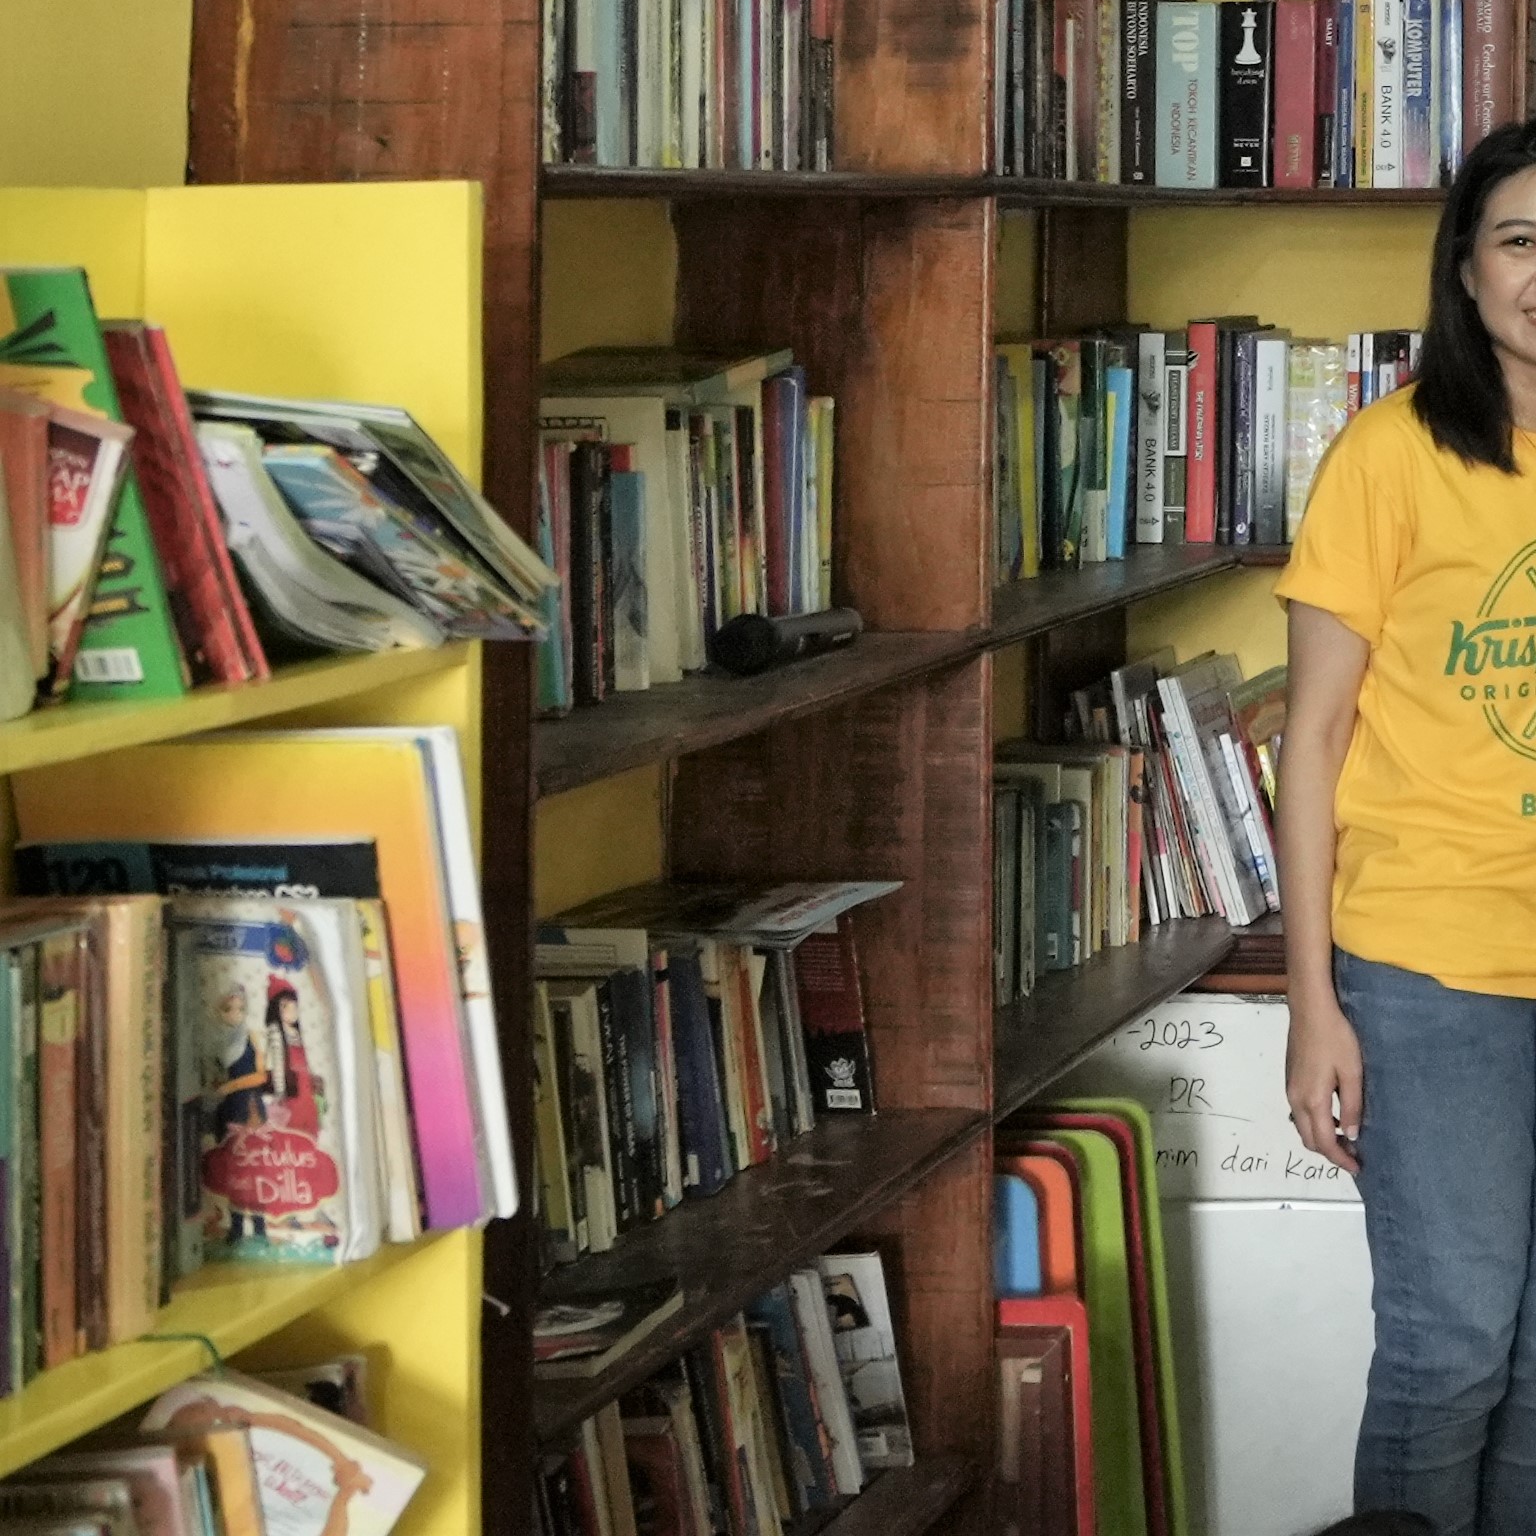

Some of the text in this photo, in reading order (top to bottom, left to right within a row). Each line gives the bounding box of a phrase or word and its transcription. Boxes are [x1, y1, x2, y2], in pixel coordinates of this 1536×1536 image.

[1126, 1, 1137, 100] BEYOND SOEHARTO
[1138, 1, 1149, 56] INDONESIA
[1171, 11, 1200, 73] TOP
[1406, 18, 1423, 98] KOMPUTER
[1171, 102, 1182, 156] INDONESIA
[1186, 78, 1198, 182] TOKOH KECANTIKAN
[1380, 85, 1393, 149] BANK 4.0
[1143, 438, 1156, 502] BANK 4.0
[1112, 1020, 1225, 1052] -2023
[1170, 1076, 1211, 1109] DR
[1220, 1142, 1270, 1174] dari
